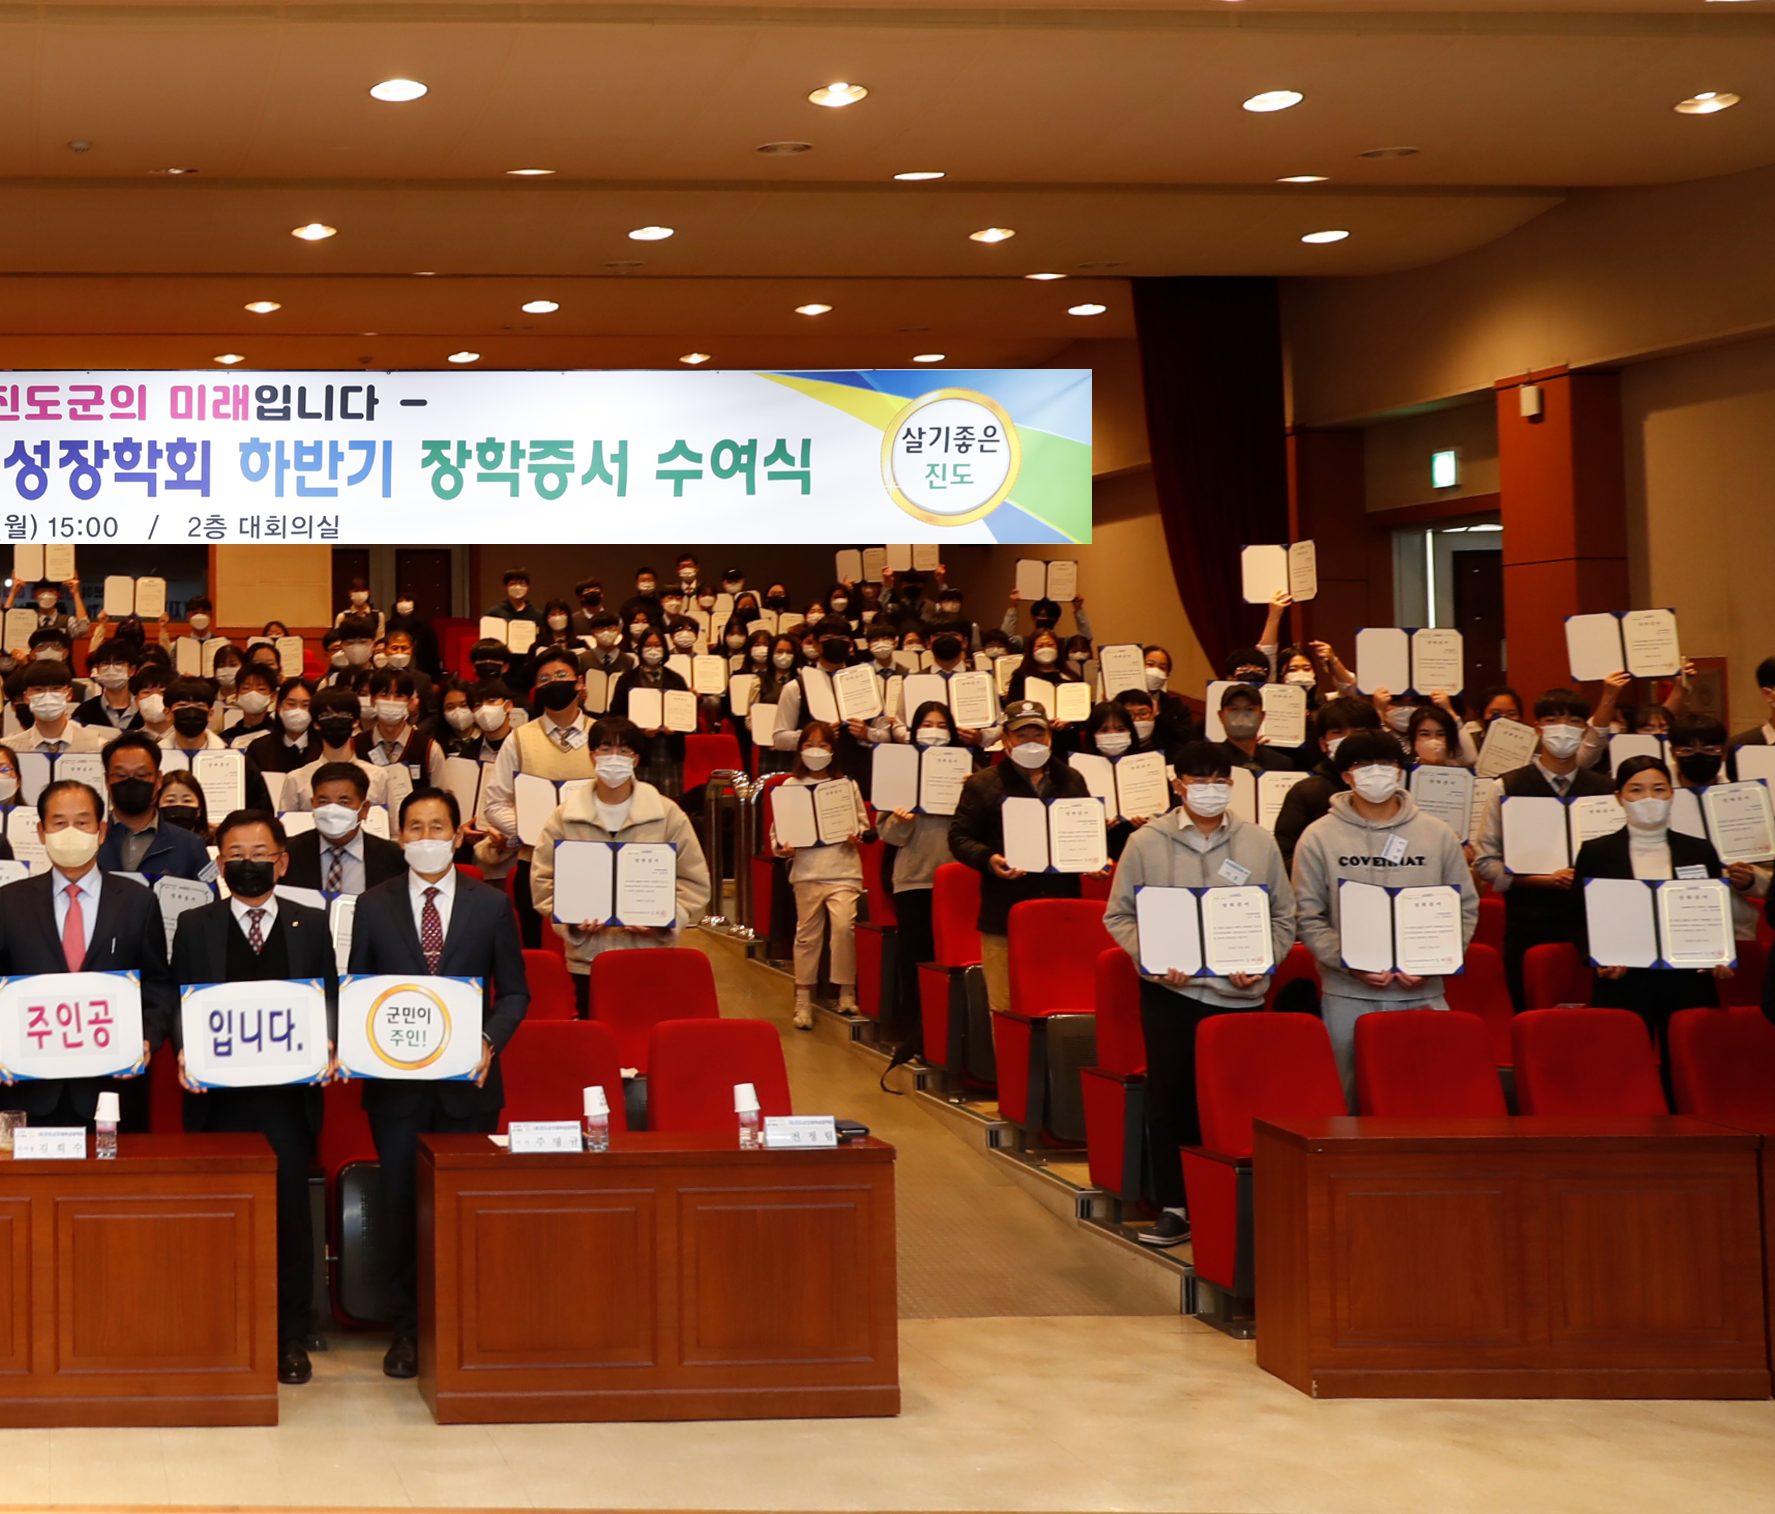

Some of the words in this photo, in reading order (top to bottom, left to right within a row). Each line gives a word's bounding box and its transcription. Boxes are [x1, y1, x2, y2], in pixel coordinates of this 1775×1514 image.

[171, 385, 379, 421] 미래입니다
[902, 425, 1000, 454] 살기좋은
[239, 438, 392, 498] 하반기
[422, 437, 627, 500] 장학증서
[656, 438, 811, 497] 수여식
[926, 463, 974, 489] 진도
[49, 517, 118, 537] 15:00
[188, 515, 227, 539] 2층
[240, 515, 338, 539] 대회의실
[27, 1001, 113, 1049] 주인공
[386, 1006, 431, 1025] 군민이
[209, 1009, 302, 1057] 입니다.
[390, 1029, 427, 1047] 주인!
